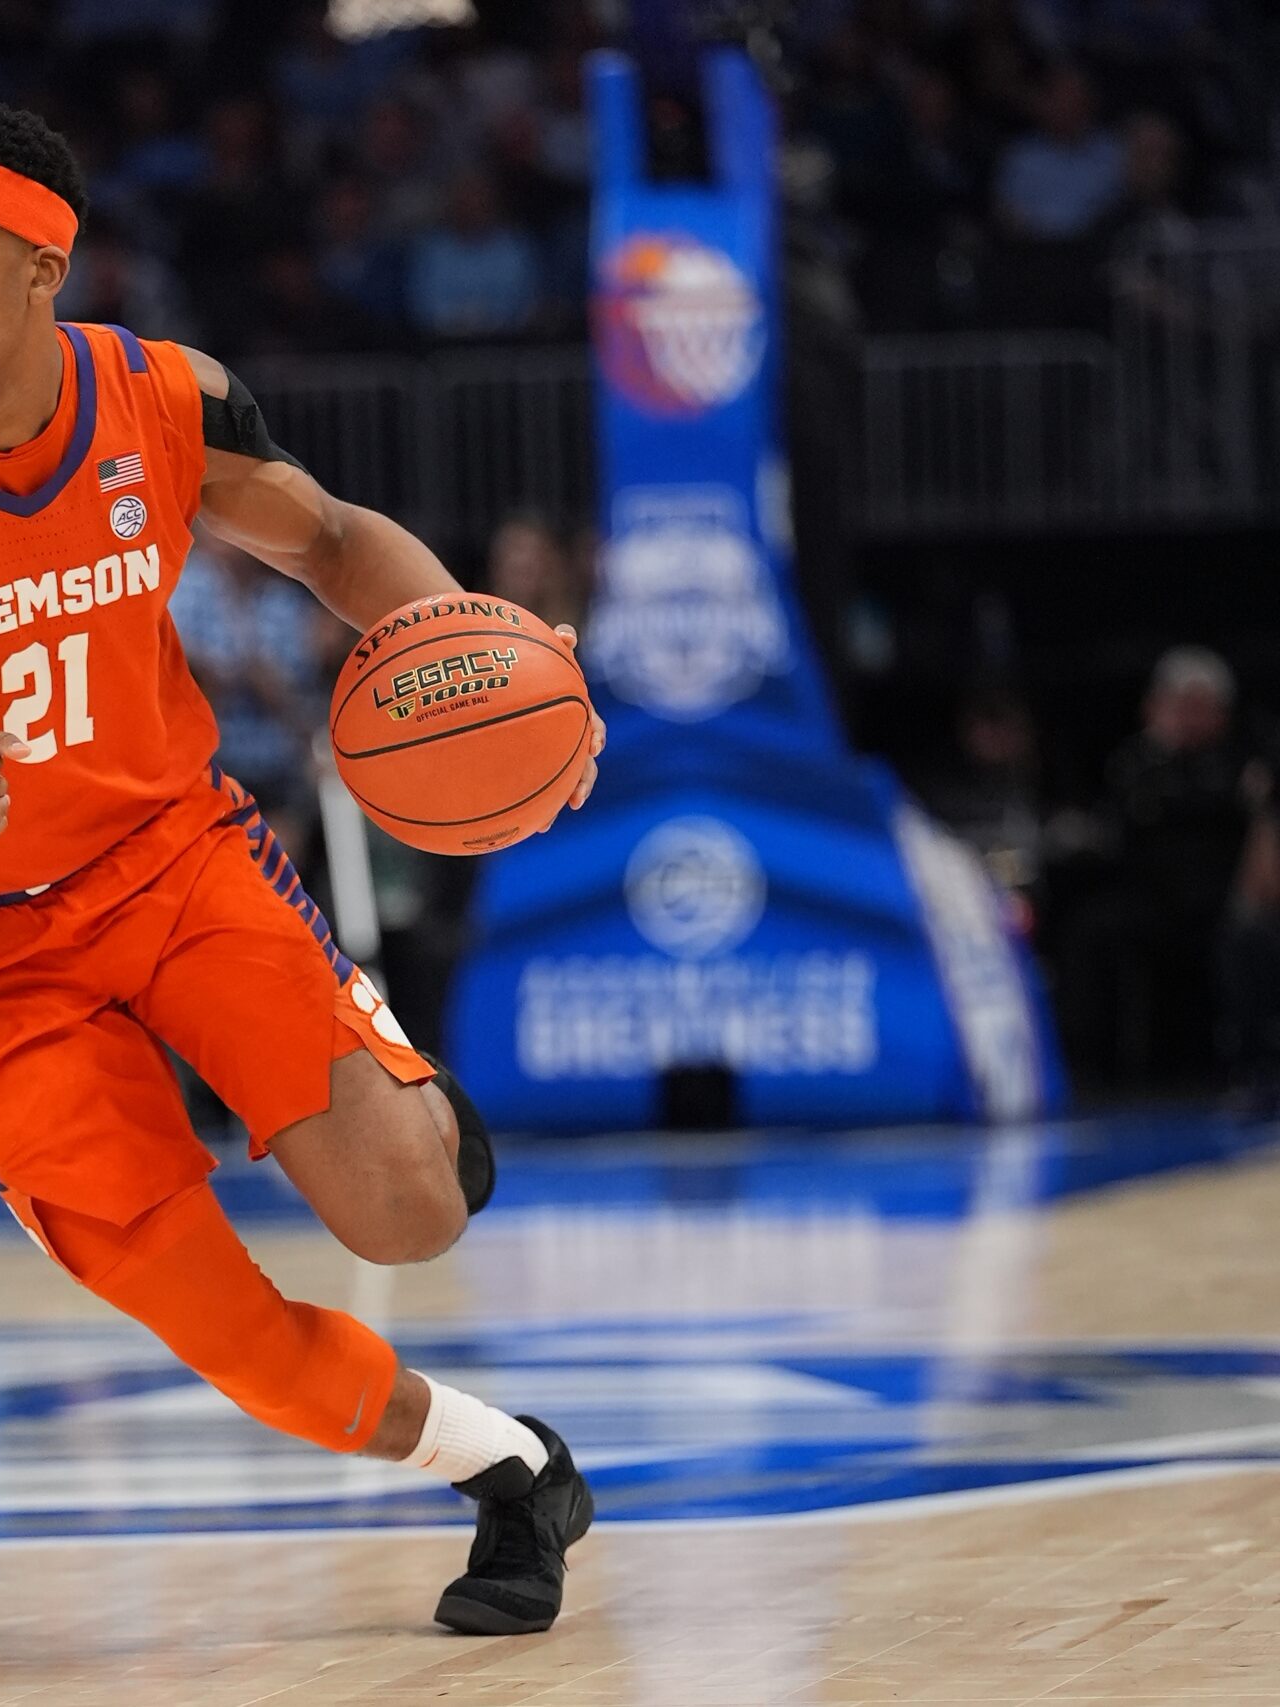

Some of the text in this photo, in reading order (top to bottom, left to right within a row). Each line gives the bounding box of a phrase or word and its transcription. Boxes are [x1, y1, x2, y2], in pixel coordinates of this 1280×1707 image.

[116, 506, 142, 523] ACC
[354, 600, 523, 671] SPALDING
[0, 632, 94, 765] 21
[372, 647, 519, 709] LEGACY
[419, 674, 511, 709] 1000
[416, 695, 490, 723] OFFICIAL GAME BALL
